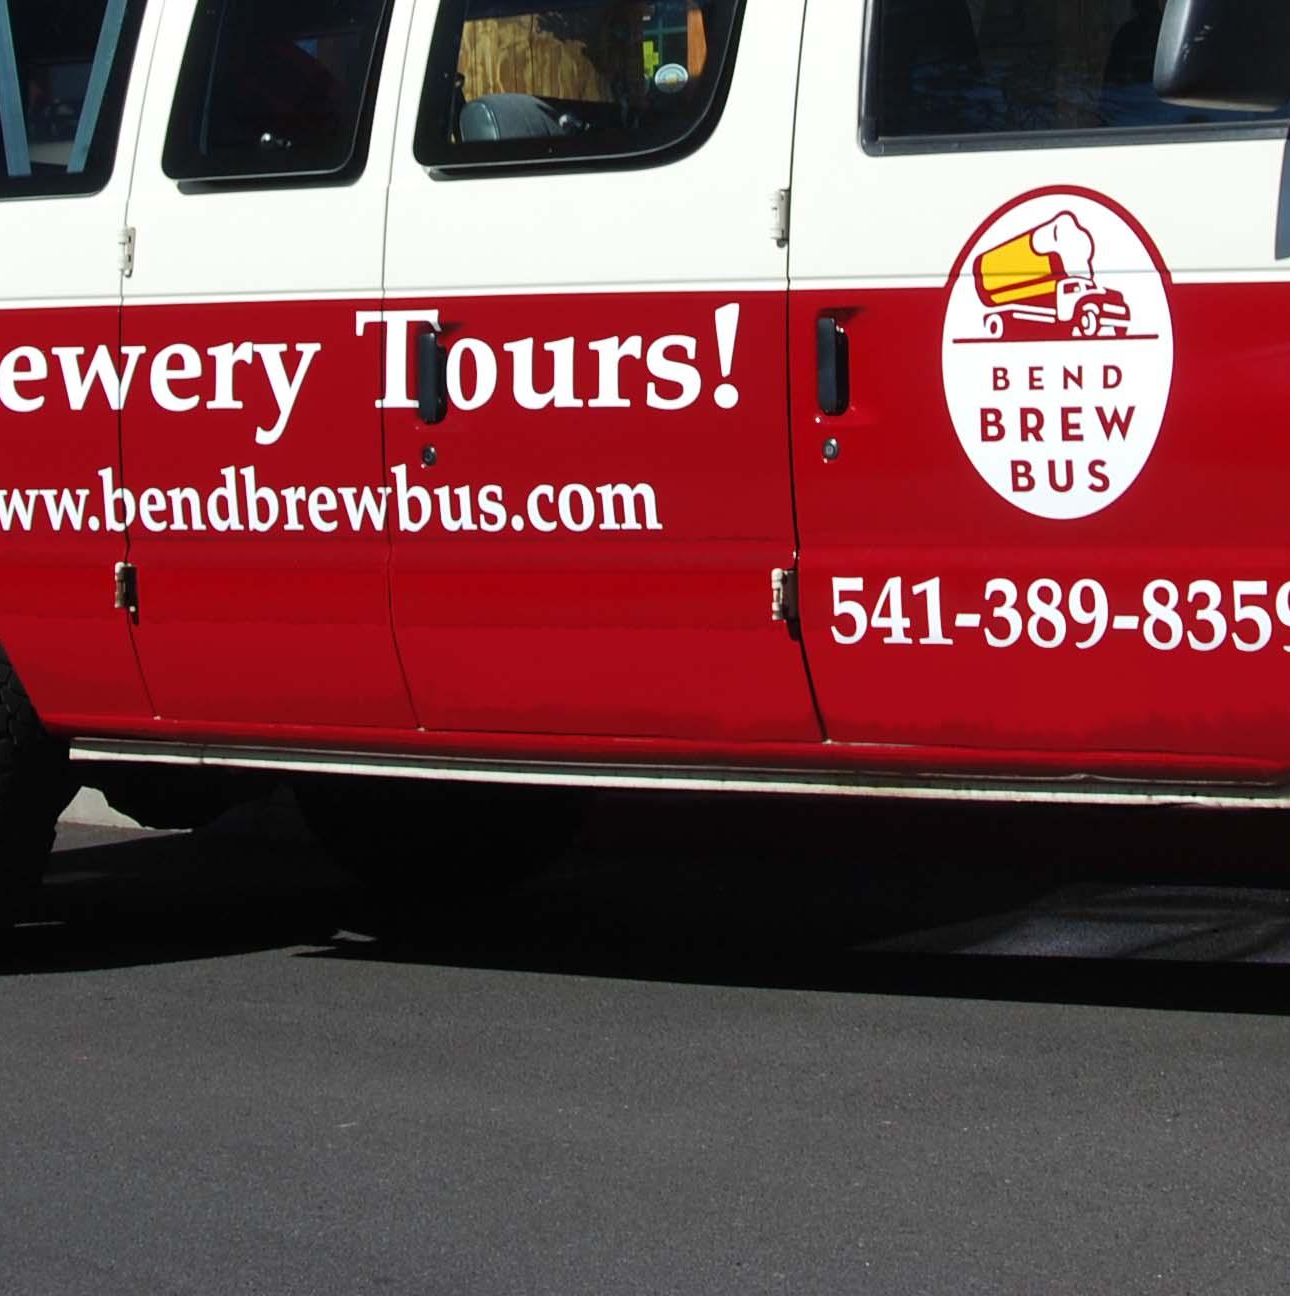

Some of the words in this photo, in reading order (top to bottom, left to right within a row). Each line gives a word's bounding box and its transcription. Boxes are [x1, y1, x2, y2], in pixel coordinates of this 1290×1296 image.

[355, 302, 741, 410] Tours!
[991, 364, 1123, 392] BEND
[979, 405, 1136, 443] BREW
[1010, 458, 1111, 493] BUS
